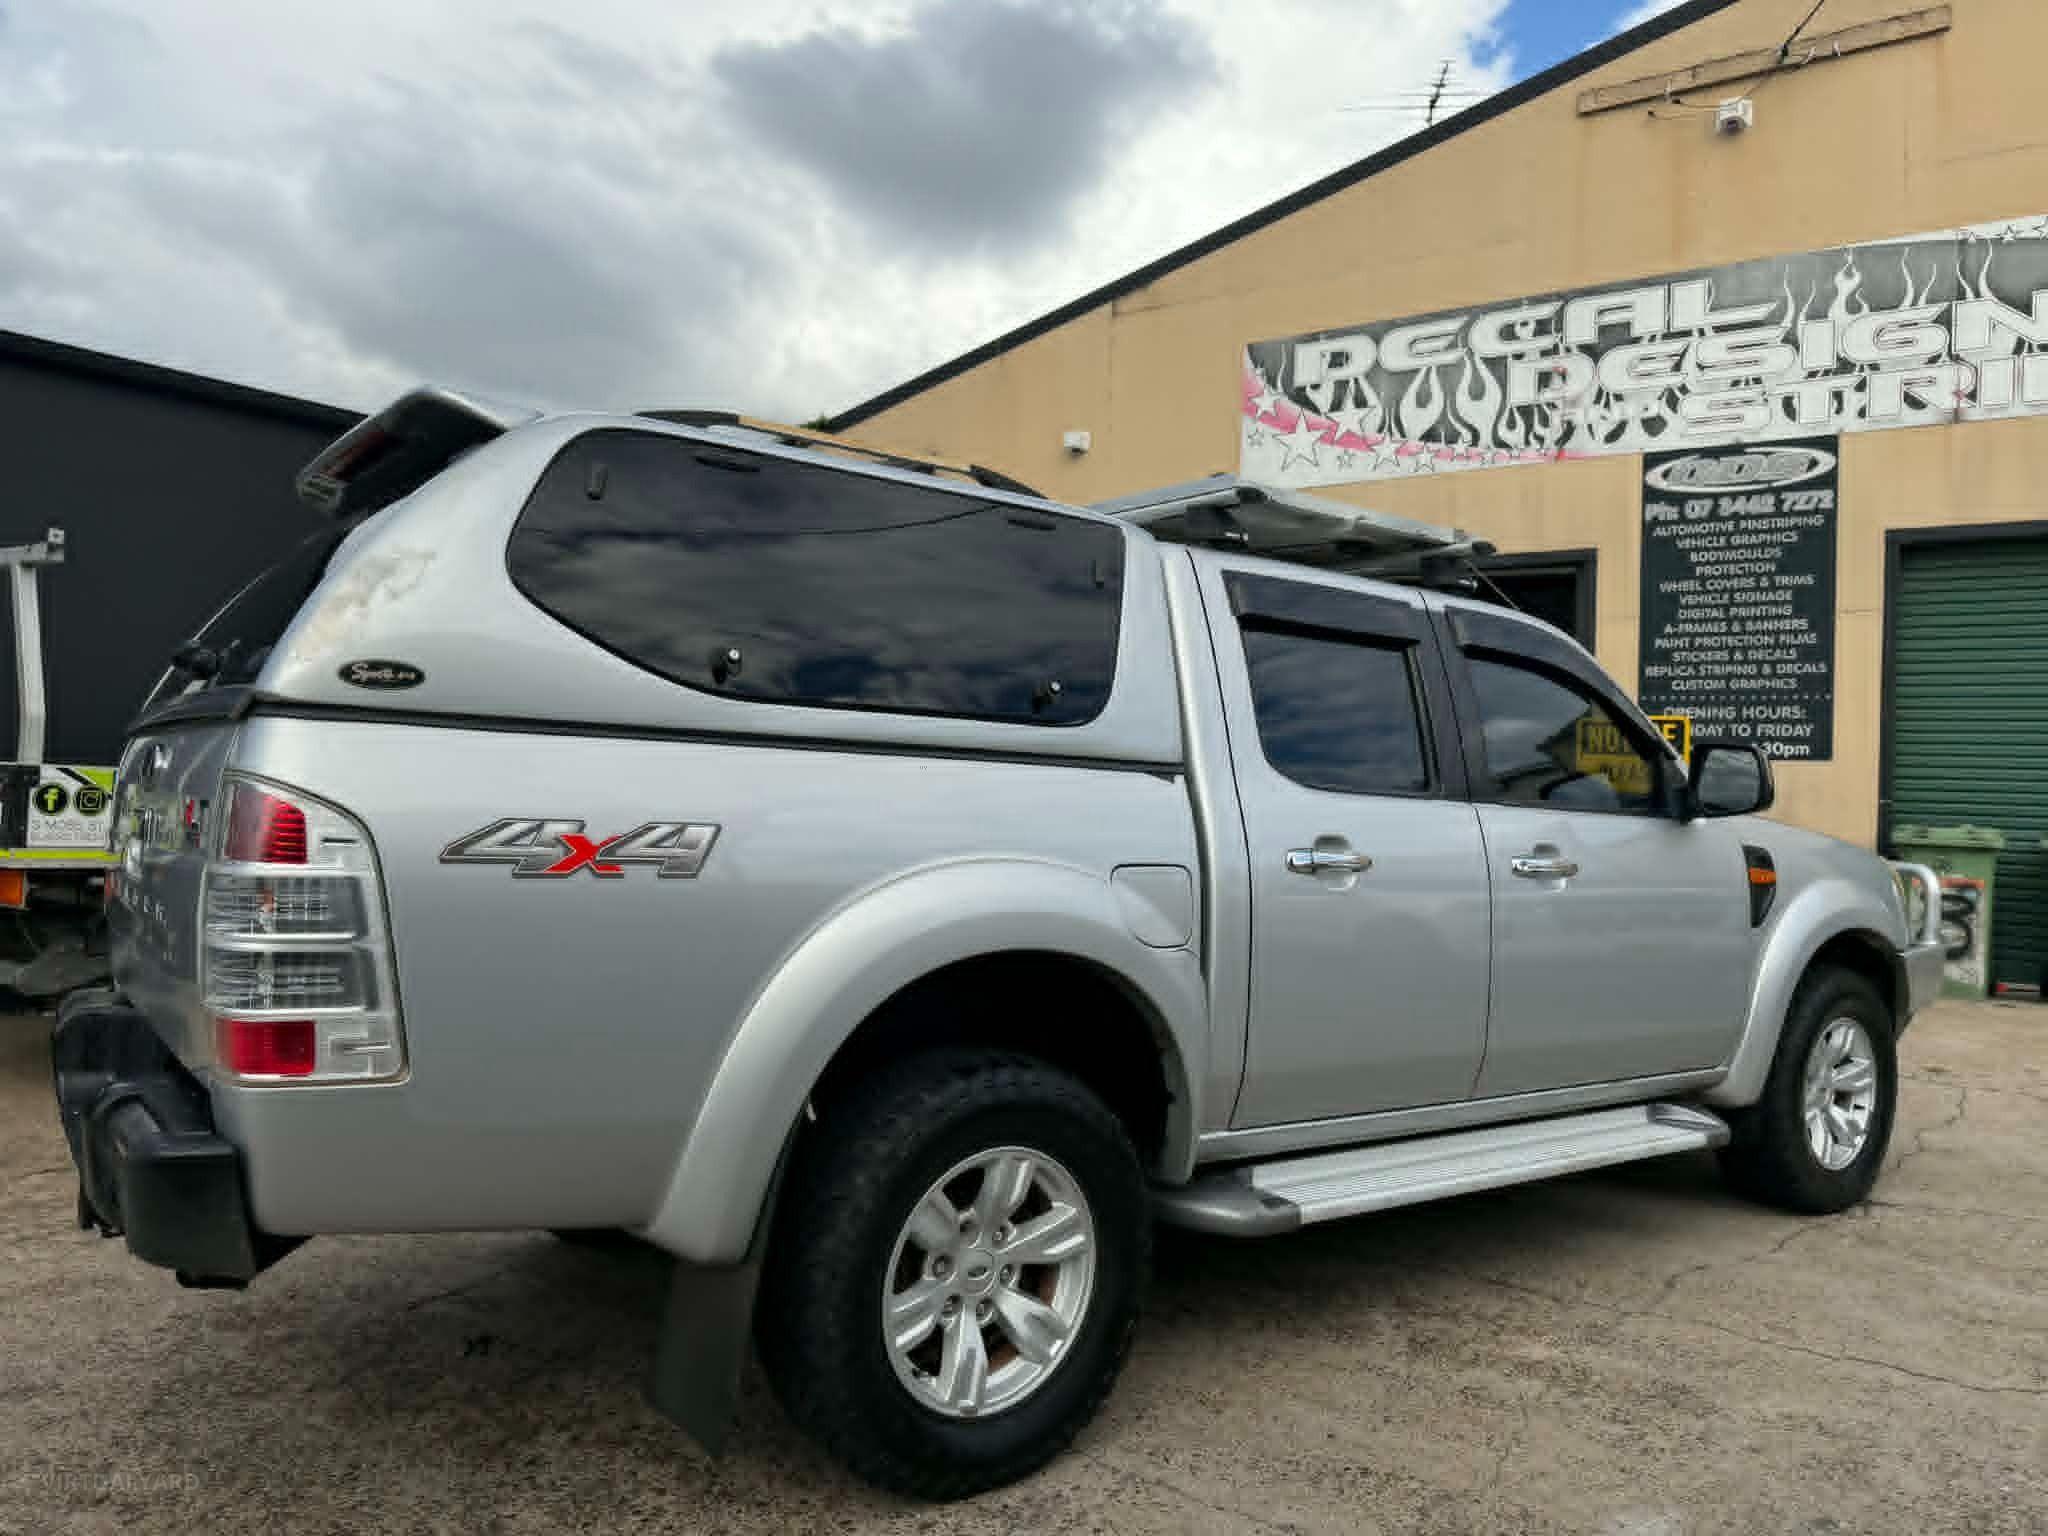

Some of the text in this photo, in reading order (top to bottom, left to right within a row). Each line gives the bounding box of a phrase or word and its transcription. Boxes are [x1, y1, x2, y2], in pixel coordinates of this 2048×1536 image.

[1294, 279, 1778, 388] DECAL
[1680, 352, 2048, 433] STRI
[1684, 498, 1714, 518] 07
[1653, 515, 1826, 537] AUTOMOTIVE PINSTRIPING
[1675, 531, 1799, 549] VEHICLE GRAPHICS
[1690, 547, 1783, 562] BODYMOULDS
[1695, 562, 1776, 577] PROTECTION
[1659, 573, 1816, 593] WHEEL COVERS & TRIMS
[1679, 589, 1793, 606] VEHICLE SIGNAGE
[1678, 604, 1793, 620] DIGITAL PRINTING
[1663, 618, 1809, 634] A-FRAMES & BANNERS
[1655, 632, 1817, 649] PAINT PROTECTION FILMS
[1671, 648, 1798, 663] STICKERS & DECALS
[1645, 661, 1828, 678] REPLICA STRIPING & DECALS
[1671, 677, 1799, 691] CUSTOM GRAPHICS
[1663, 705, 1808, 720] OPENING HOURS:
[1730, 724, 1751, 737] TO
[1756, 723, 1814, 737] FRIDAY
